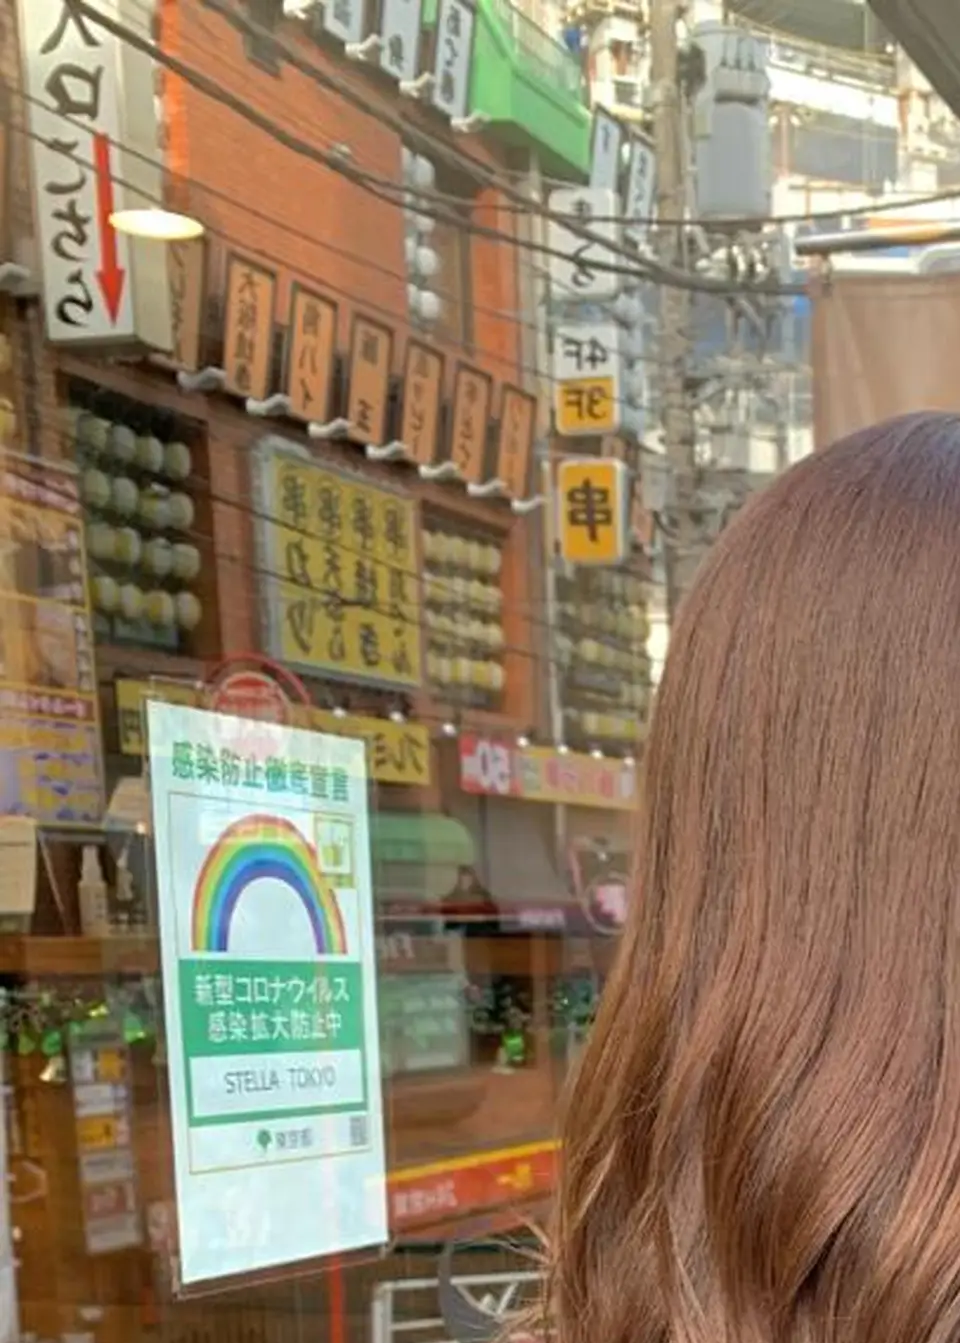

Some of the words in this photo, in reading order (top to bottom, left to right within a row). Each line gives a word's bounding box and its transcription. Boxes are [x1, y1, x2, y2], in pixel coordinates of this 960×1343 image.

[194, 973, 350, 1006] 新型コロナウイルス
[208, 1009, 342, 1043] 感染拡大防止中
[223, 1069, 280, 1095] STELLA
[287, 1065, 337, 1091] TOKYO
